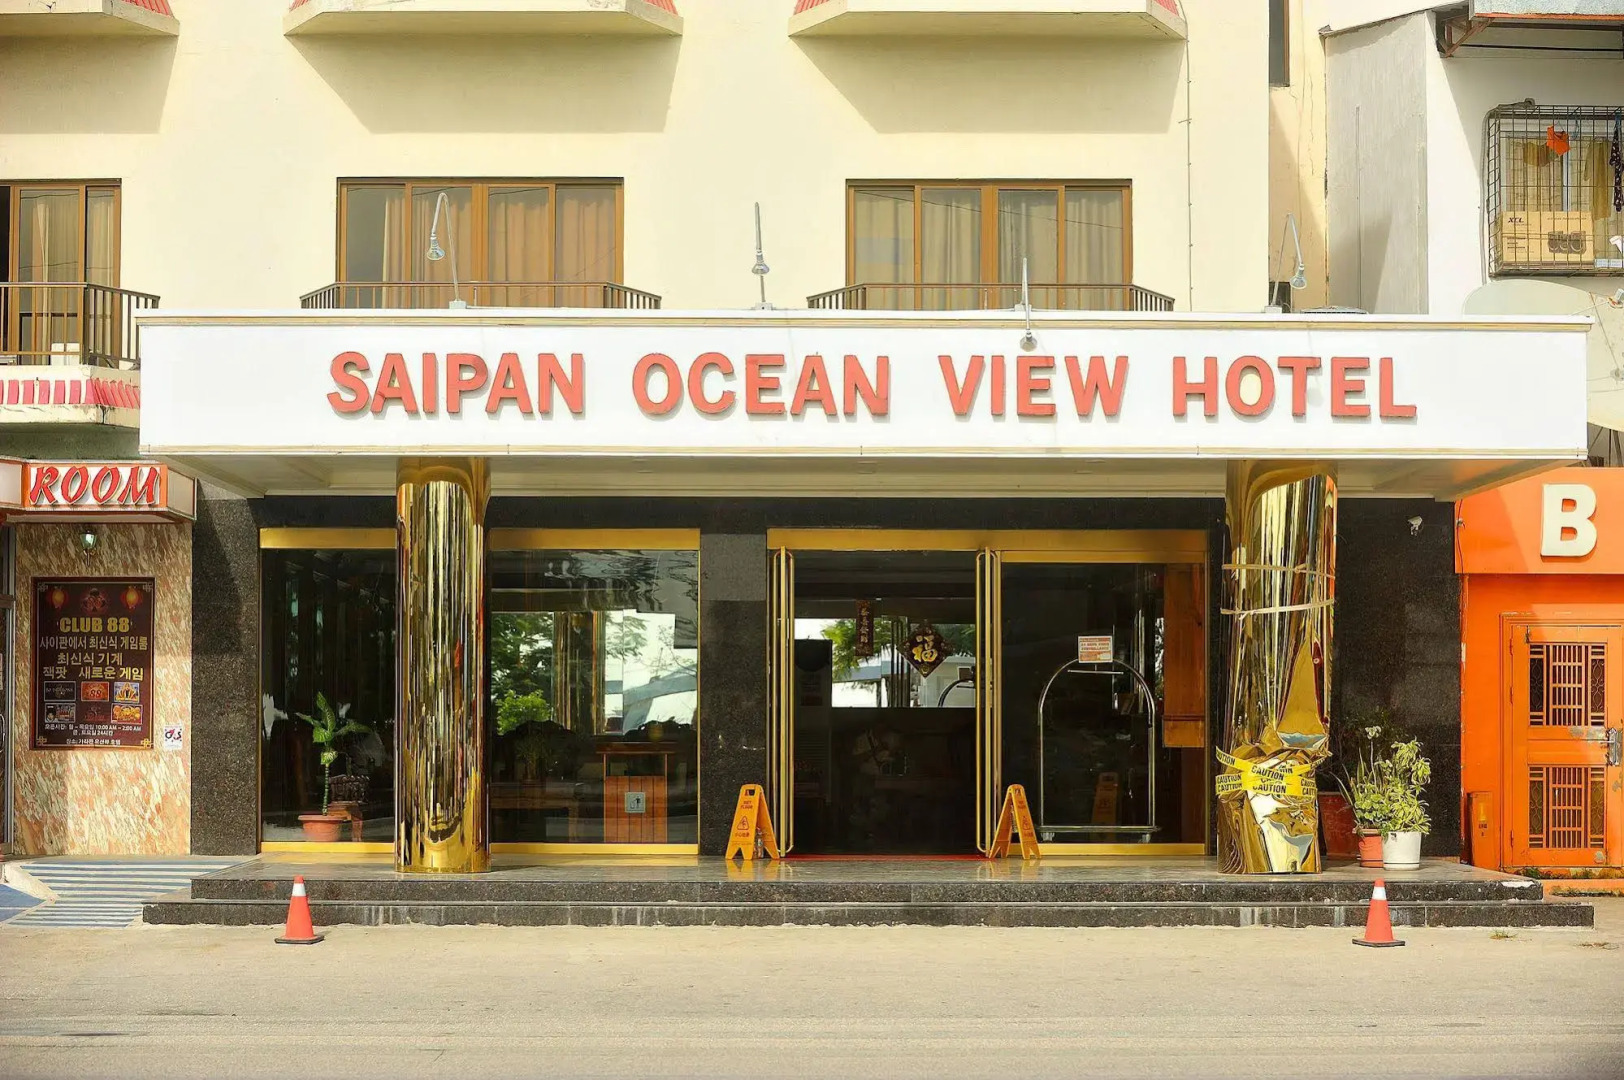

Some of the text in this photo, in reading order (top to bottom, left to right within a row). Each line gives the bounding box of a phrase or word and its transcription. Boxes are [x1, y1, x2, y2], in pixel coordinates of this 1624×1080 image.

[327, 351, 1417, 417] SAIPAN OCEAN VIEW HOTEL
[29, 465, 161, 505] ROOM
[1541, 484, 1598, 558] B
[59, 617, 130, 632] CLUB 88
[40, 636, 148, 650] 사이판에서 최신식 게임룸
[912, 635, 938, 662] 福
[57, 652, 123, 665] 최신식 기계
[43, 666, 144, 681] 잭팟 새로운 게임
[1217, 774, 1242, 785] CAUTION
[1251, 765, 1285, 781] CAUTION
[1217, 782, 1243, 793] CAUTION
